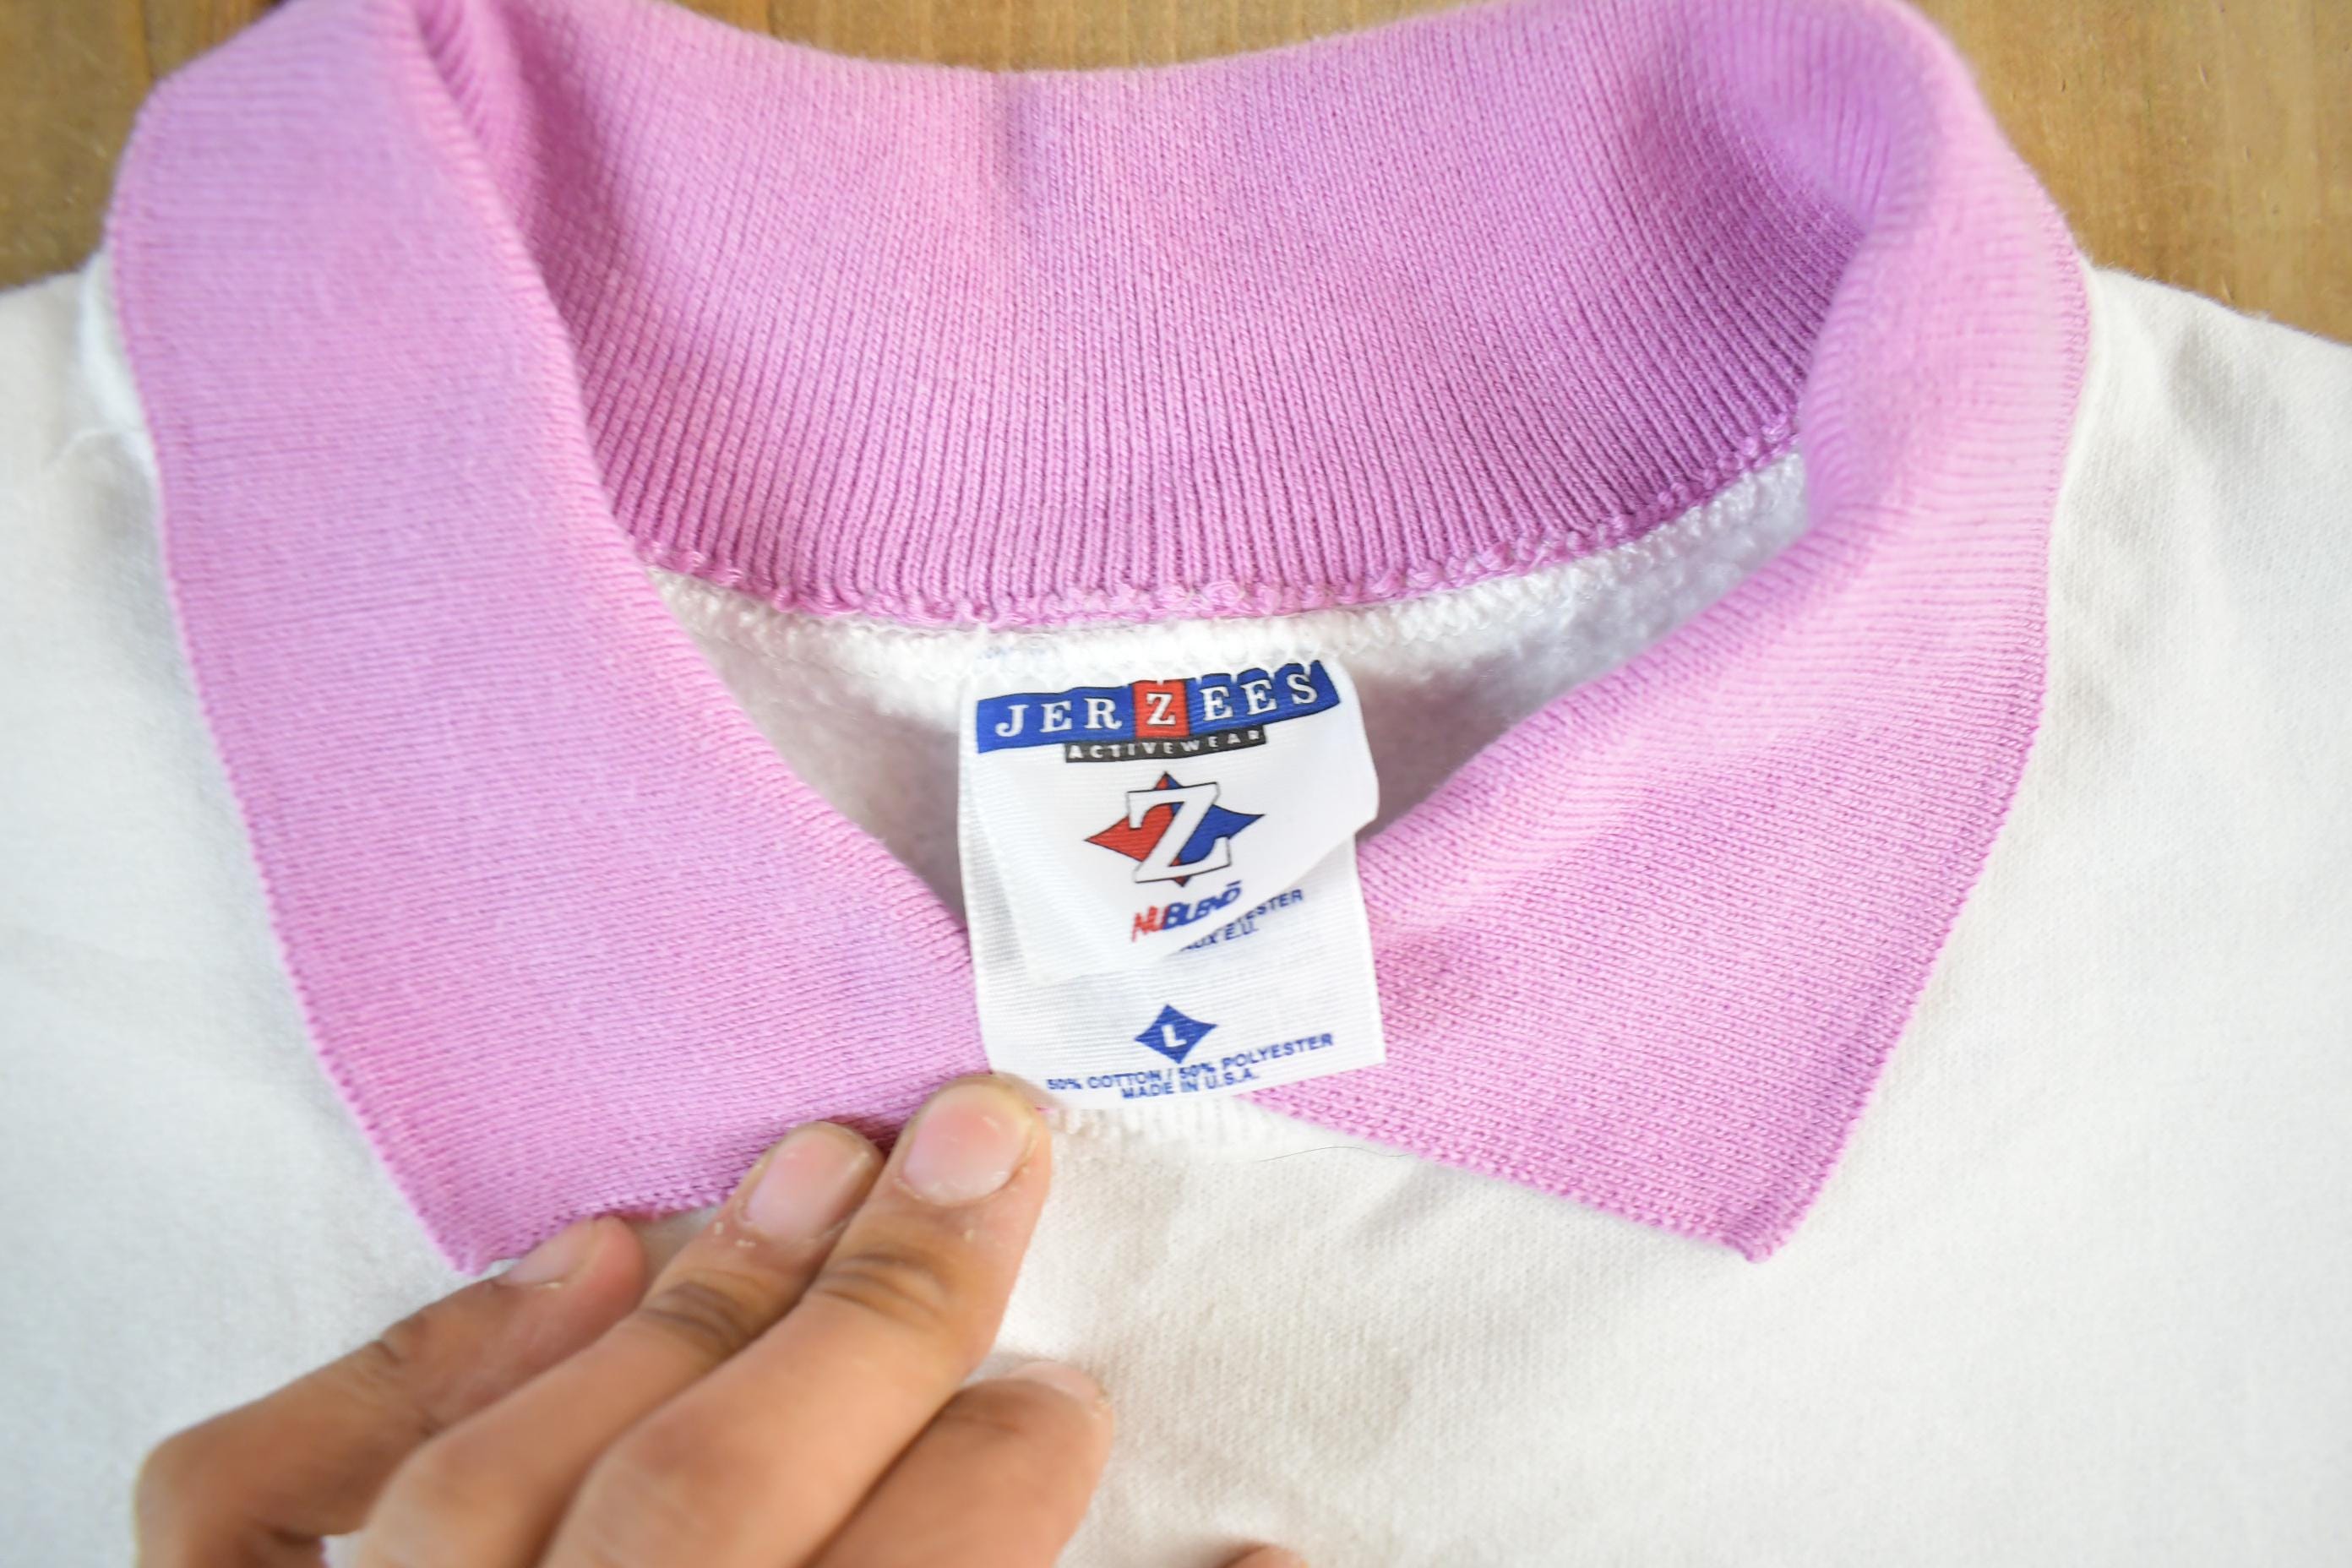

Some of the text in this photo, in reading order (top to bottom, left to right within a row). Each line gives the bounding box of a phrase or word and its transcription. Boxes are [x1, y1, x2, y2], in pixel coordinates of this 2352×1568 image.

[994, 673, 1320, 738] JERZEES
[1068, 730, 1262, 760] ACTIVEWEAR
[1125, 781, 1233, 884] Z
[1161, 1023, 1187, 1048] L
[1047, 1078, 1082, 1090] 50%
[1087, 1070, 1162, 1089] COTTON
[1179, 1062, 1217, 1079] 50%
[1222, 1032, 1334, 1070] POLYESTER
[1120, 1067, 1260, 1099] MADE IN U.S.A.
